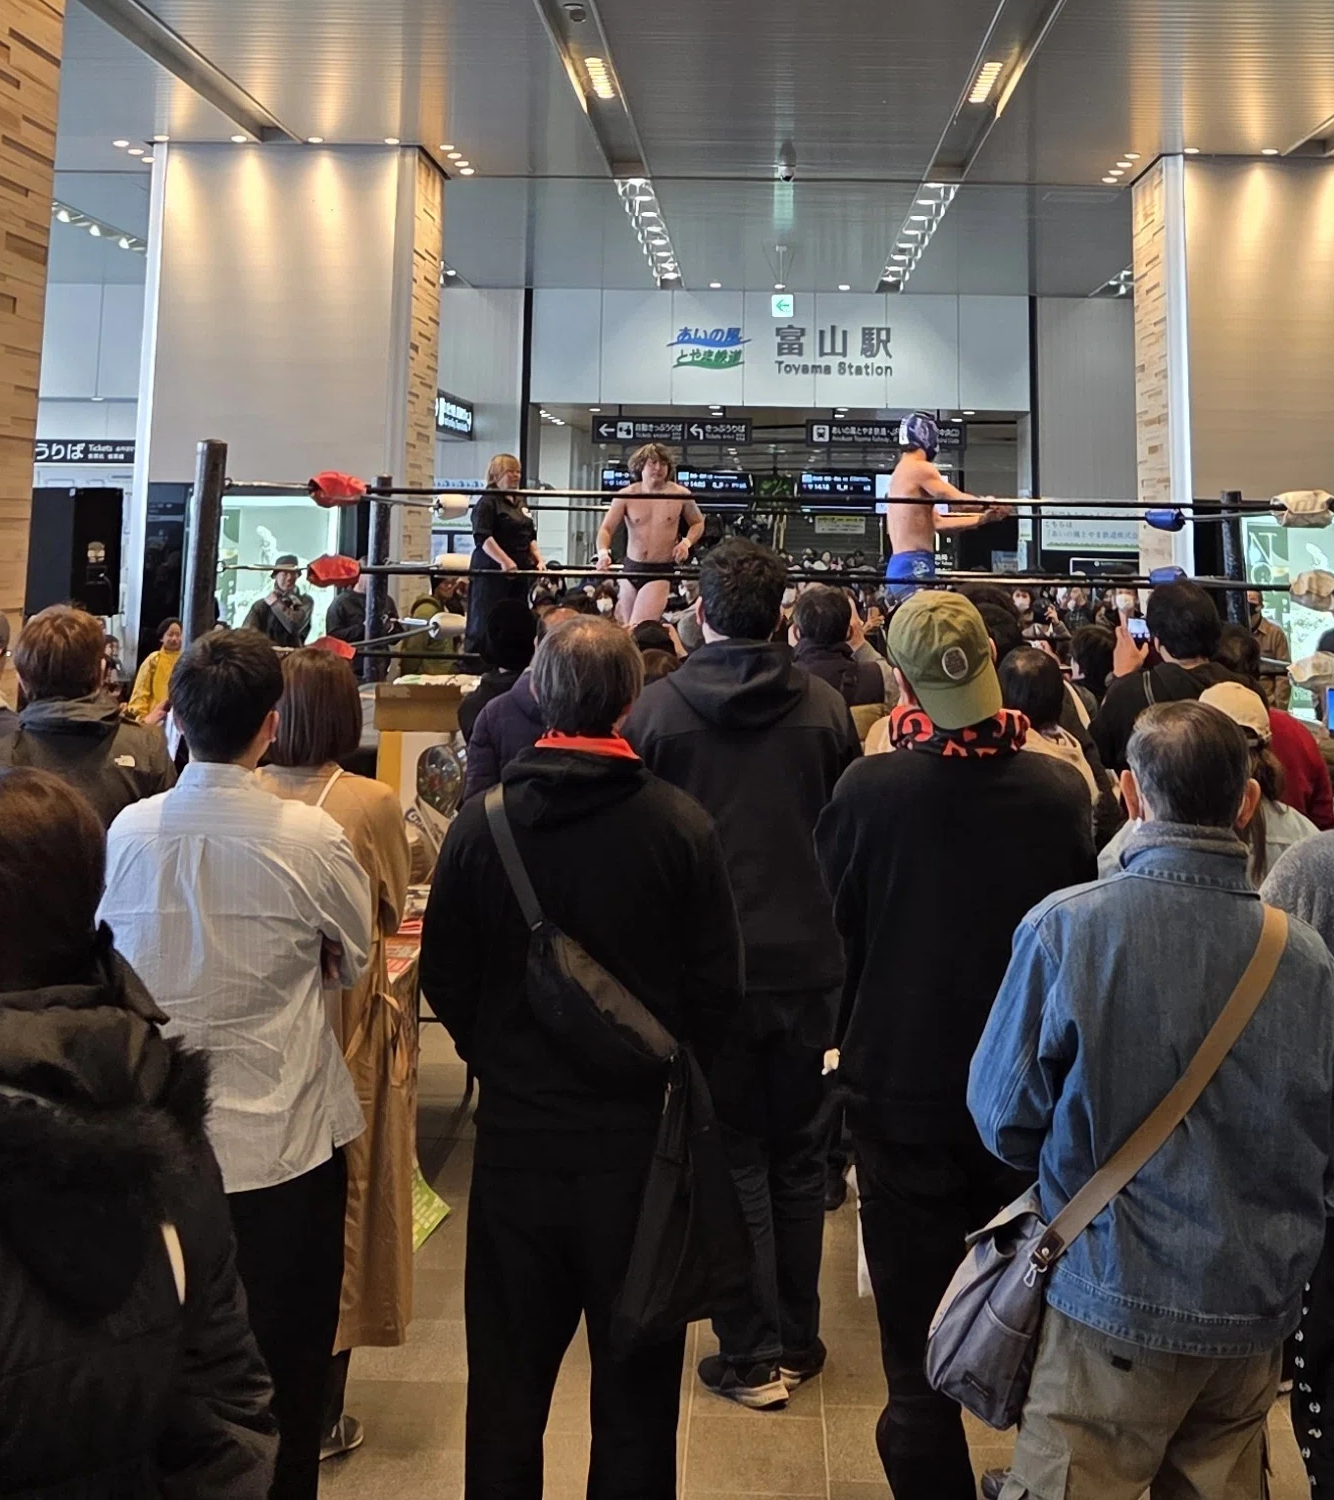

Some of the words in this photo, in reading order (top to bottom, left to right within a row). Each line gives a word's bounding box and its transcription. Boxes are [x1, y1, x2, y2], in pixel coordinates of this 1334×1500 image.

[676, 326, 742, 343] あいの風
[775, 324, 893, 359] 富山駅
[775, 361, 832, 376] Toyama
[837, 361, 893, 377] Station
[35, 443, 85, 460] うりば
